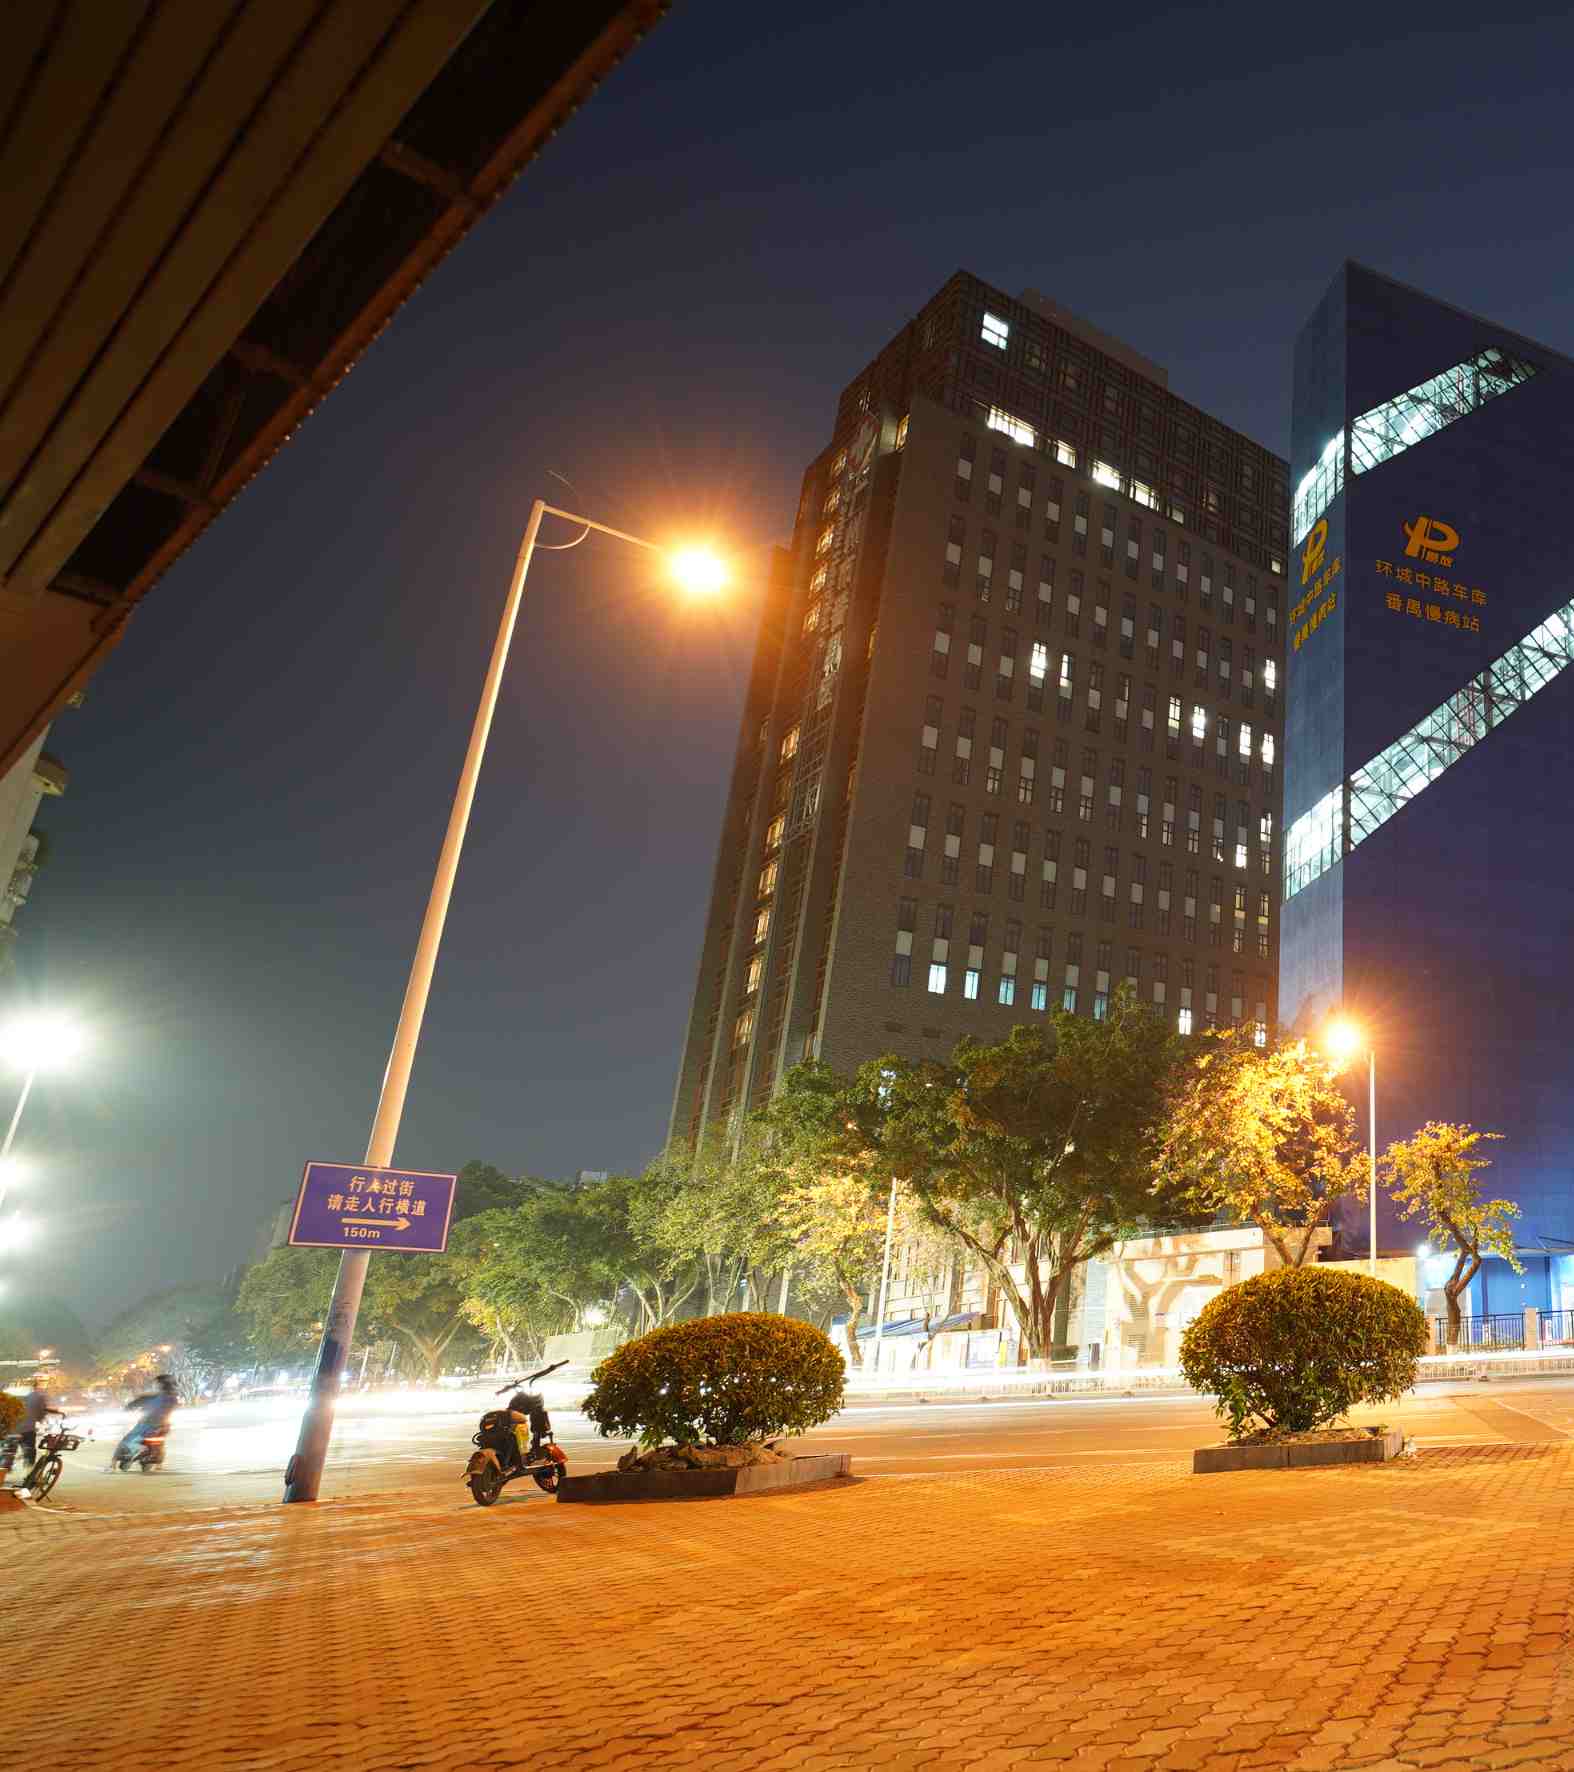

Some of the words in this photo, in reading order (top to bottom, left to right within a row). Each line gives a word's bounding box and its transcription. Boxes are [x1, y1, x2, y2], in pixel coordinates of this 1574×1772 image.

[1375, 560, 1488, 606] 环城中路车库
[349, 1175, 416, 1196] 行人过街
[327, 1194, 426, 1216] 请走人行横道
[343, 1227, 380, 1239] 150m
